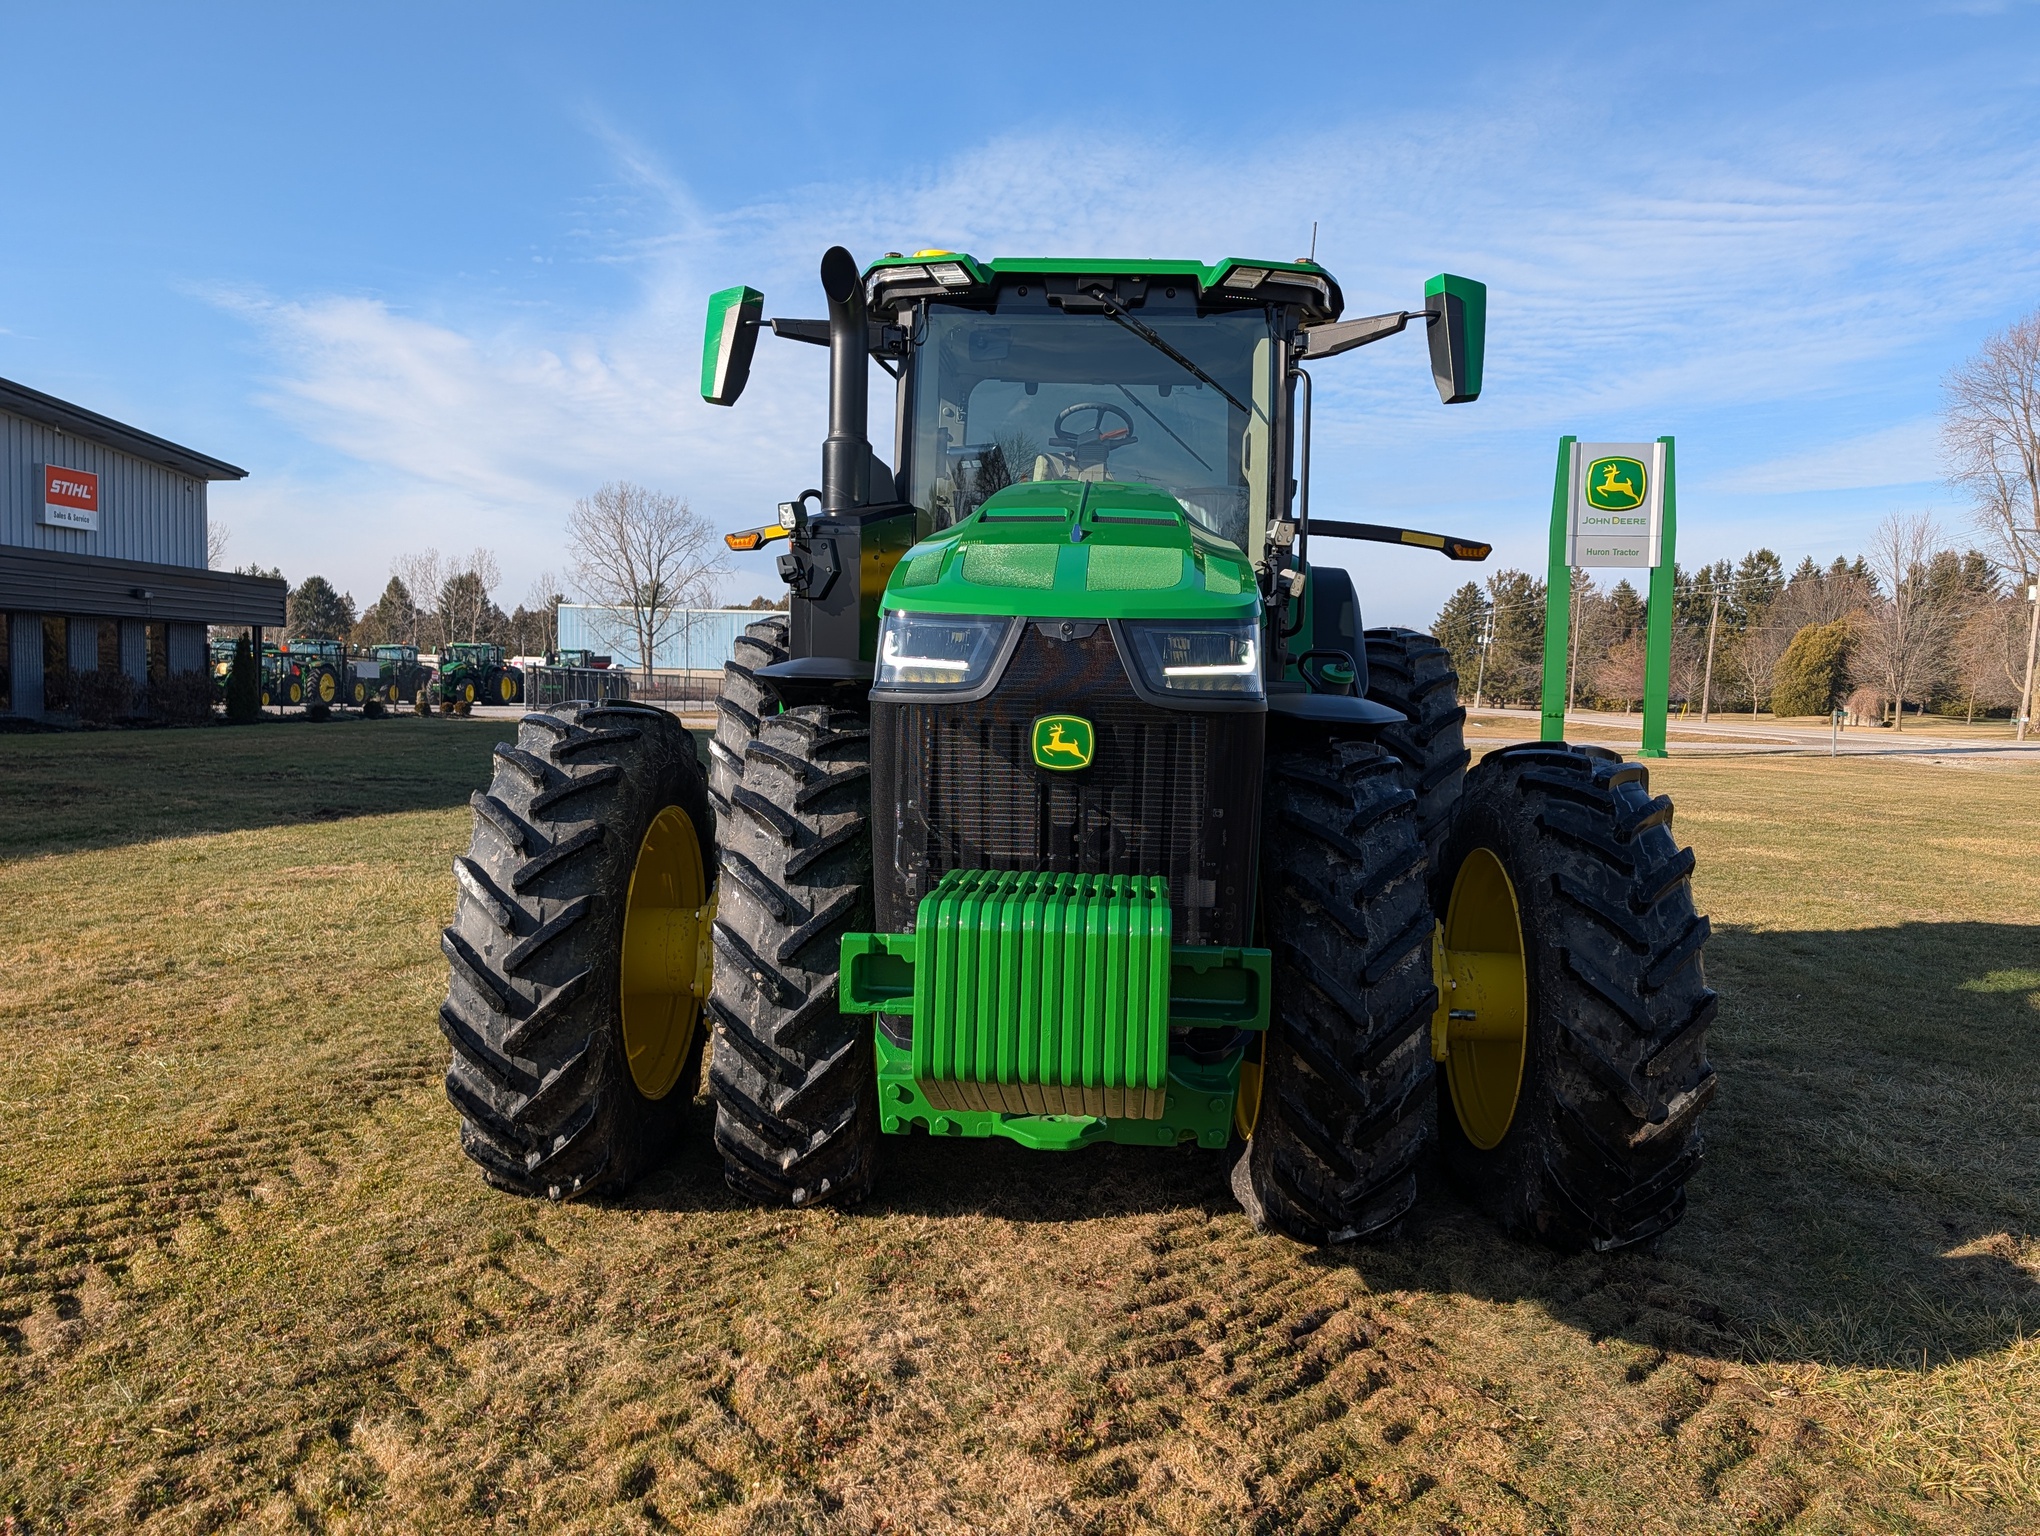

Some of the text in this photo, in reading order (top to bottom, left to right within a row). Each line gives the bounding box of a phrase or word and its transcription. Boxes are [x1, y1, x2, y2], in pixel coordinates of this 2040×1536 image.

[50, 479, 91, 499] STIHL
[53, 510, 90, 524] Sales & Service
[1582, 516, 1647, 525] JOHN DEERE
[1586, 548, 1640, 556] Huron Tractor
